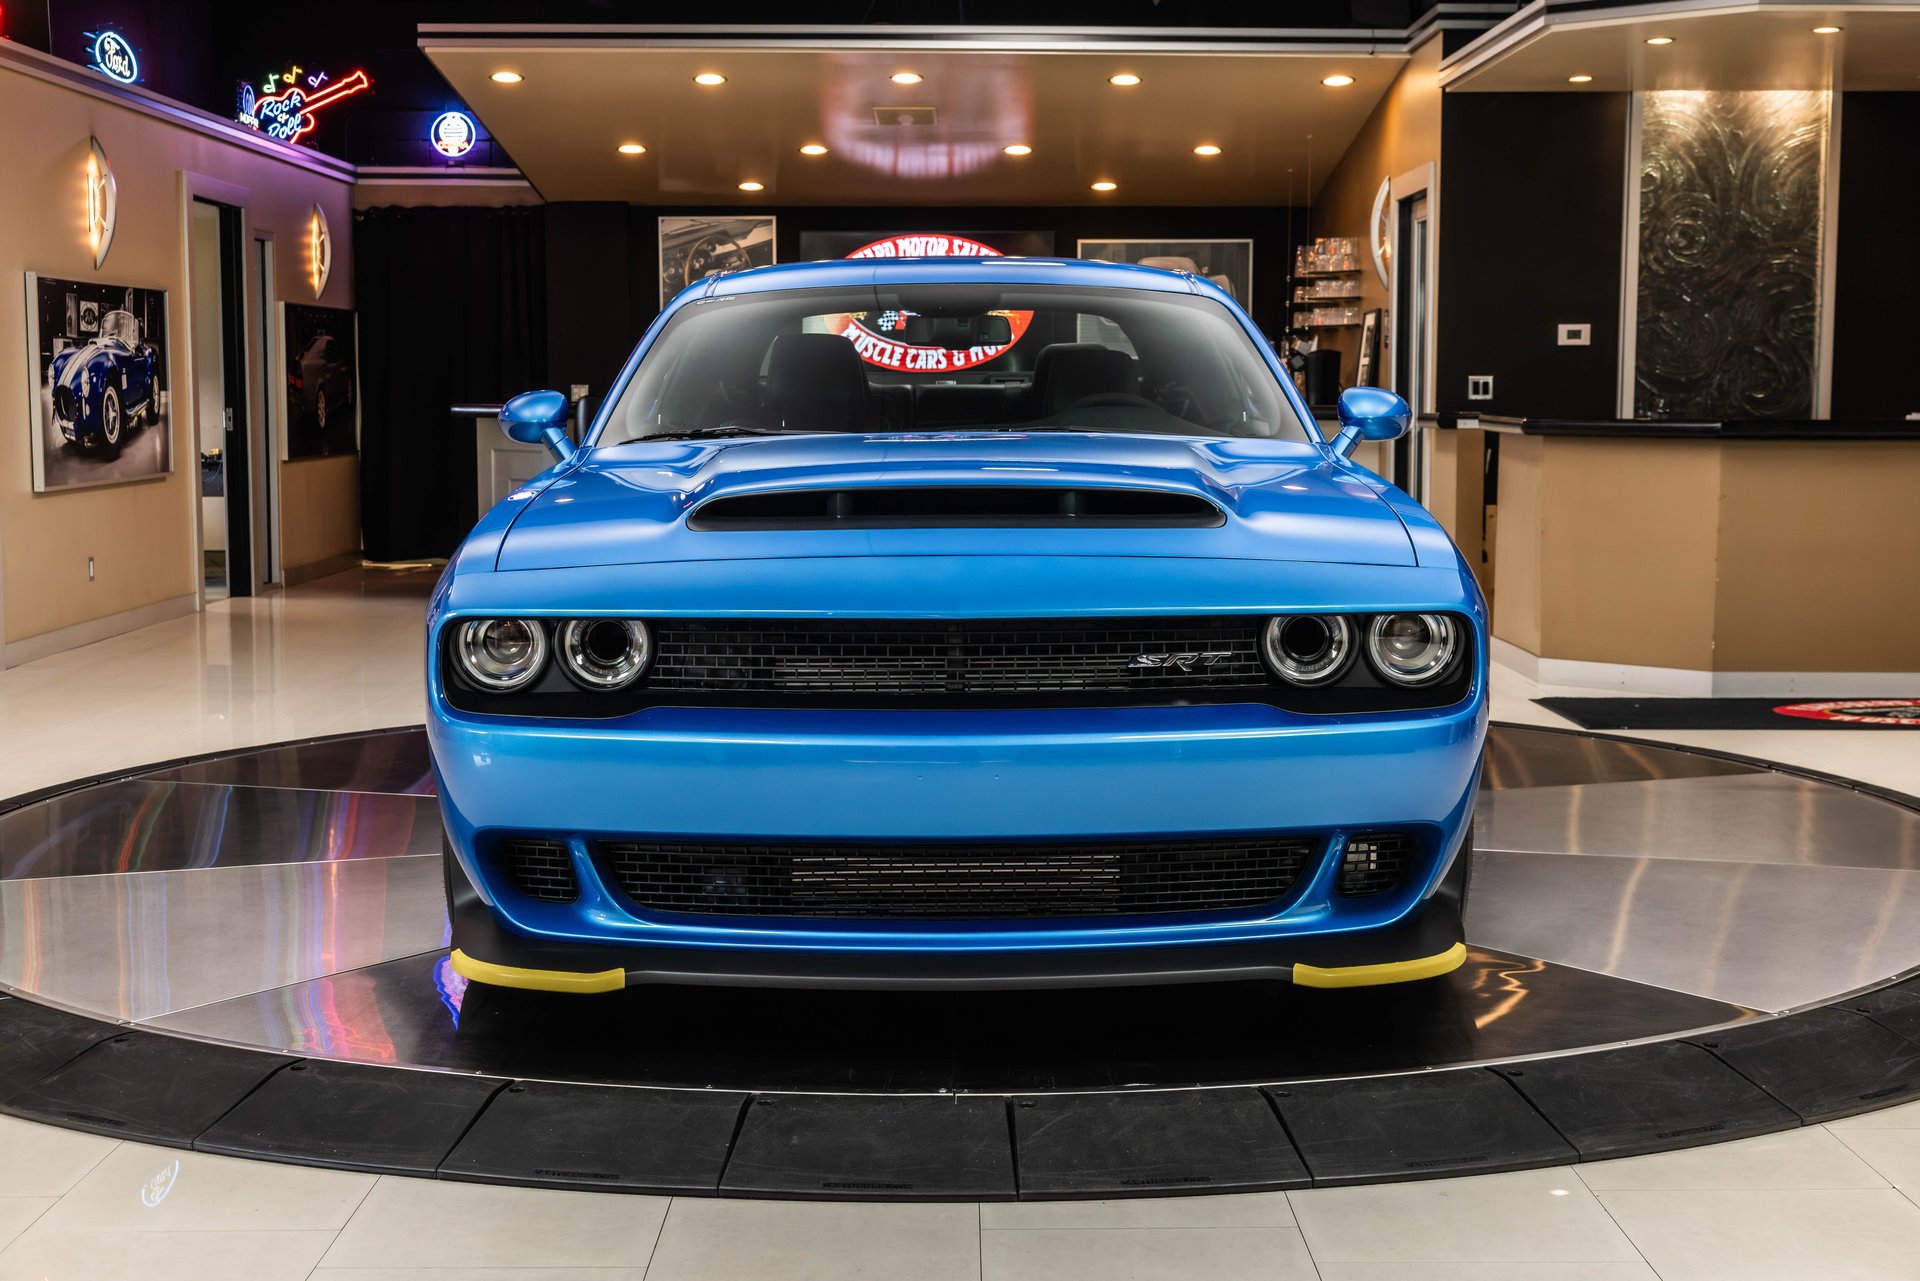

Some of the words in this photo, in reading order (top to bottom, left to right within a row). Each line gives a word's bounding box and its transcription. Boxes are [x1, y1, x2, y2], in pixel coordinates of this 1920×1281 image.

[104, 37, 131, 77] Ford
[261, 89, 301, 119] Rock
[896, 236, 949, 257] MOTOR
[841, 323, 904, 367] MUSCLE
[906, 348, 947, 370] CARS
[1128, 652, 1232, 672] SRT
